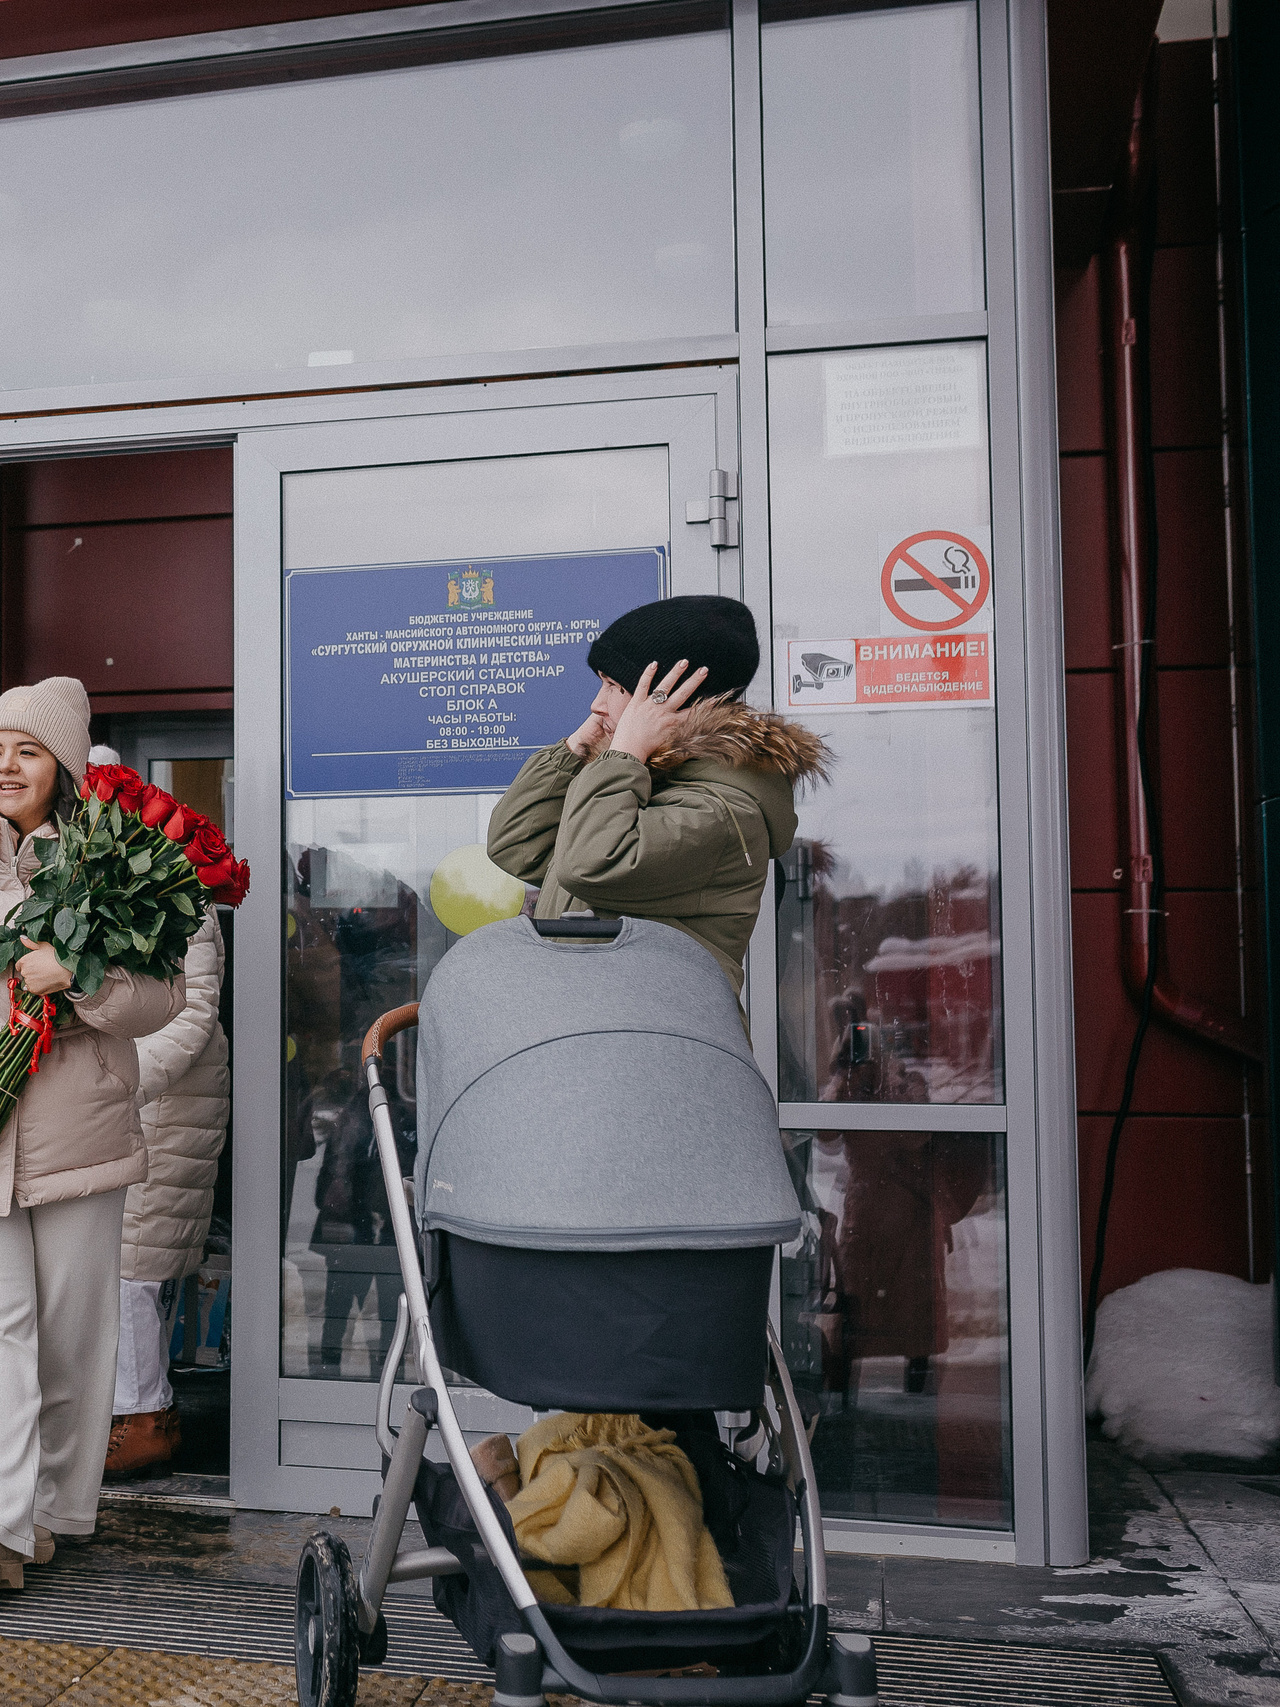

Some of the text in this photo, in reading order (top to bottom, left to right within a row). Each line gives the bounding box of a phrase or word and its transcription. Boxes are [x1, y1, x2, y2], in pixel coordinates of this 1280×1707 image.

[409, 609, 534, 626] БЮДЖЕТНОЕ УЧРЕЖДЕНИЕ
[346, 631, 378, 641] ХАНТЫ
[385, 627, 453, 639] МАНСИЙСКОГО
[456, 623, 525, 636] АВТОНОМНОГО
[527, 621, 563, 632] ОКРУГА
[570, 619, 600, 630] ЮГРЫ
[311, 641, 387, 656] «СУРГУТСКИЙ
[390, 637, 453, 653] ОКРУЖНОЙ
[456, 632, 542, 649] КЛИНИЧЕСКИЙ
[545, 631, 583, 646] ЦЕНТР
[860, 640, 985, 661] ВНИМАНИЕ!
[393, 651, 550, 669] МАТЕРИНСТВА И ДЕТСТВА»
[380, 665, 565, 685] АКУШЕРСКИЙ СТАЦИОНАР
[896, 671, 949, 683] ВЕДЕТСЯ
[419, 682, 525, 698] СТОЛ СПРАВОК
[863, 681, 983, 695] ВИДЕОНАБЛЮДЕНИЕ
[446, 699, 498, 712] БЛОК А
[427, 712, 517, 725] ЧАСЫ РАБОТЫ:
[439, 726, 468, 737] 08:00
[477, 725, 506, 735] 19:00
[426, 736, 520, 749] БЕЗ ВЫХОДНЫХ
